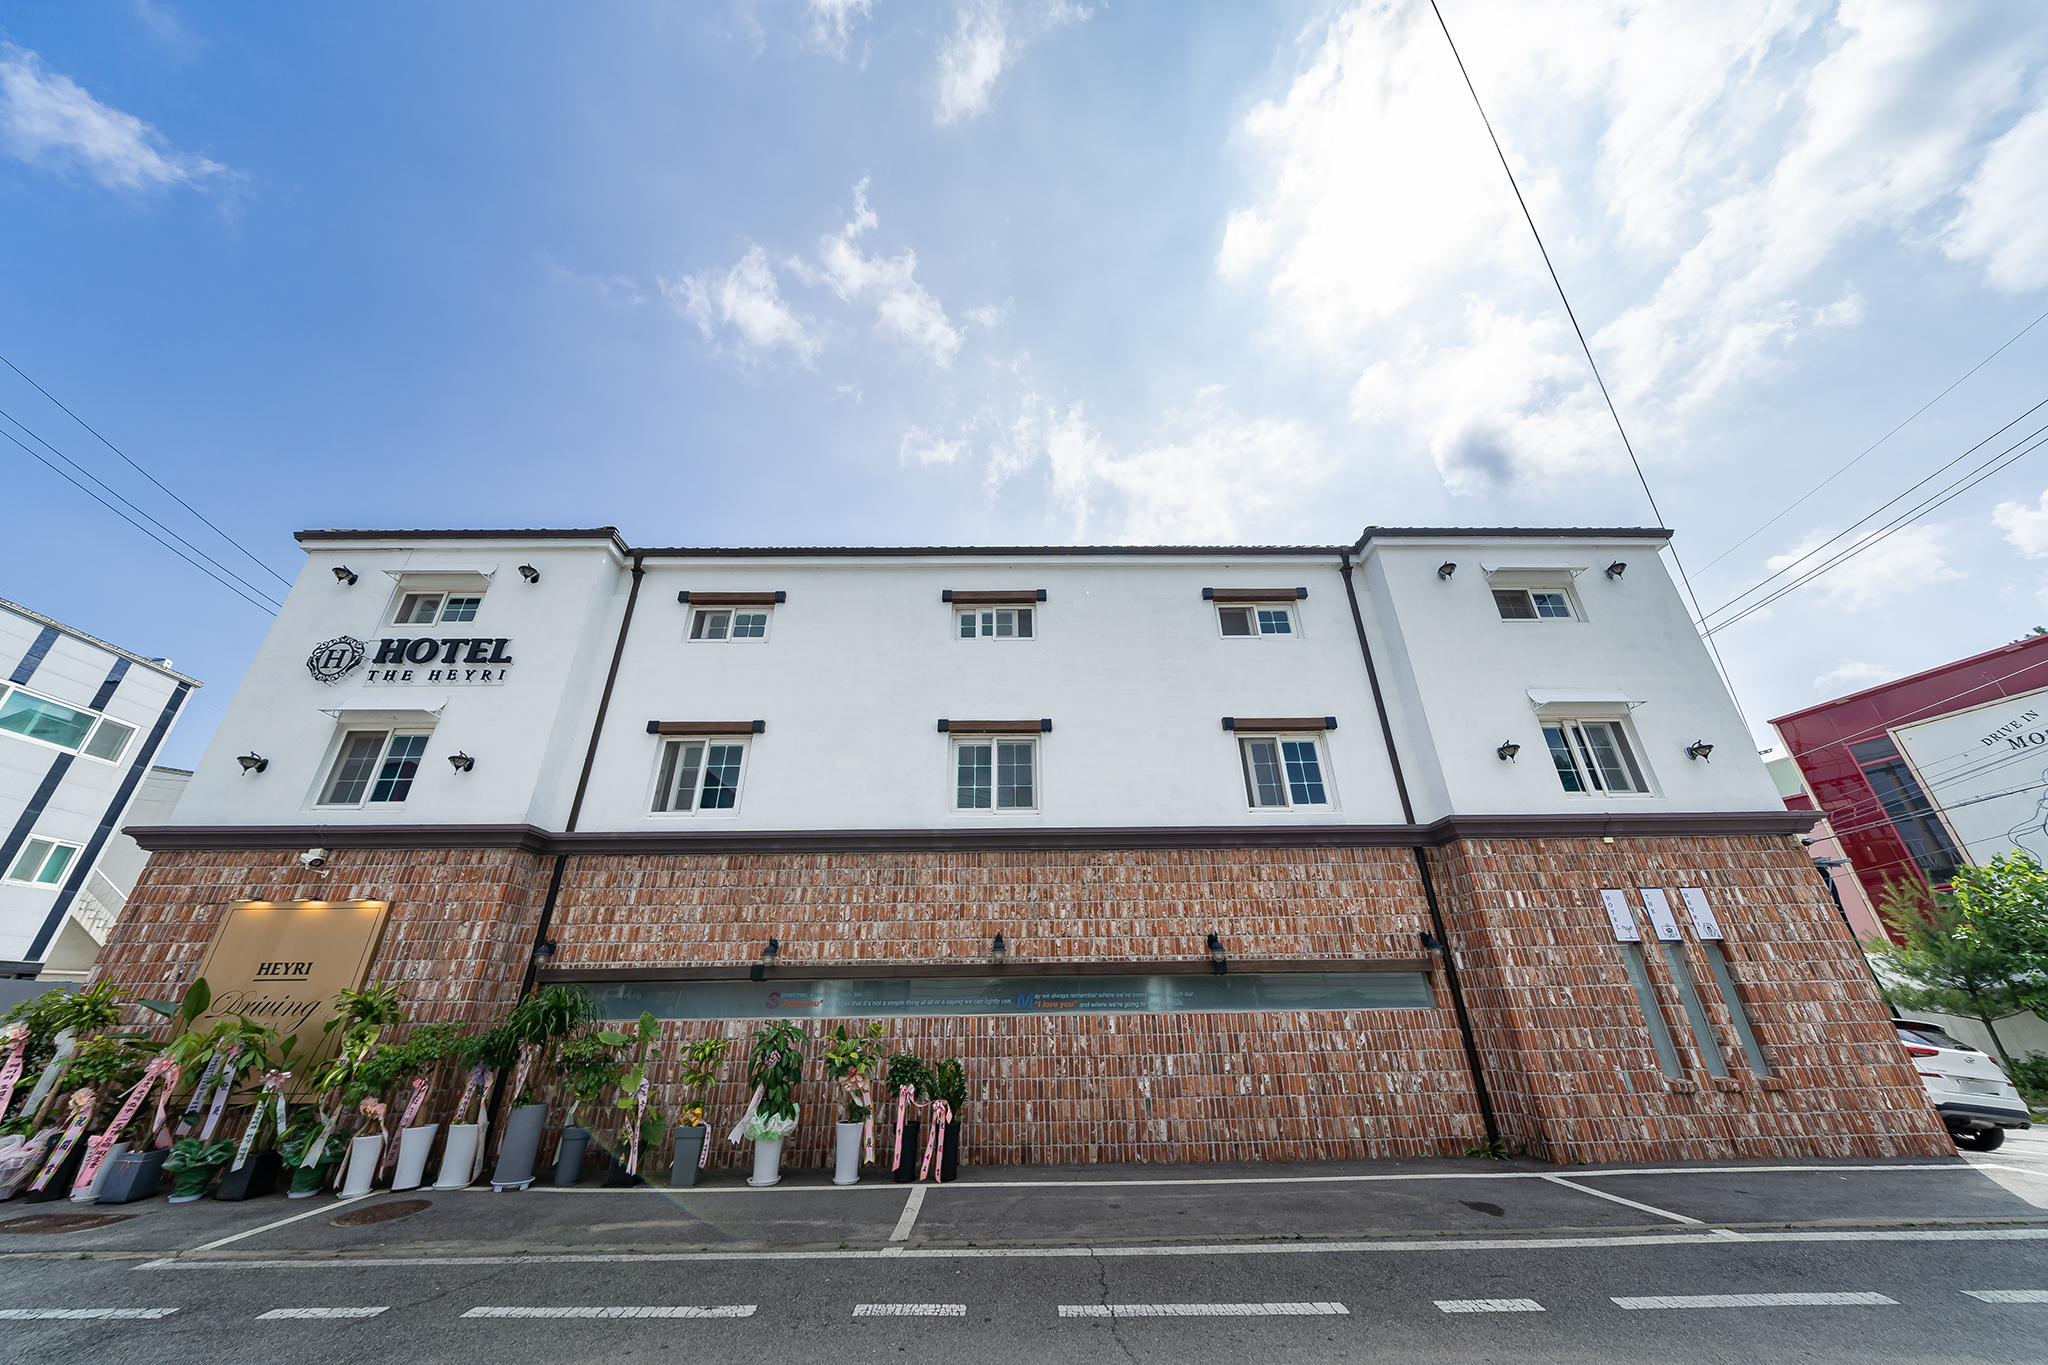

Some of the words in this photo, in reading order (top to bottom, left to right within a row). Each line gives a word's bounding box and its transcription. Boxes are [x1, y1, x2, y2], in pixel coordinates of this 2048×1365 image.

[372, 638, 513, 664] HOTEL
[367, 670, 413, 681] THE
[428, 669, 507, 681] HEYRI
[1981, 720, 2022, 746] DRIVE
[2021, 710, 2040, 722] IN
[2006, 732, 2048, 750] MO
[1605, 895, 1621, 930] HOTEL
[1644, 894, 1656, 915] THE
[1683, 892, 1701, 928] HEYRI
[256, 962, 313, 976] HEYRI
[204, 990, 322, 1034] Driving
[887, 1000, 905, 1008] simple
[906, 999, 920, 1008] thing
[1042, 1000, 1059, 1008] love
[1124, 1001, 1140, 1009] going
